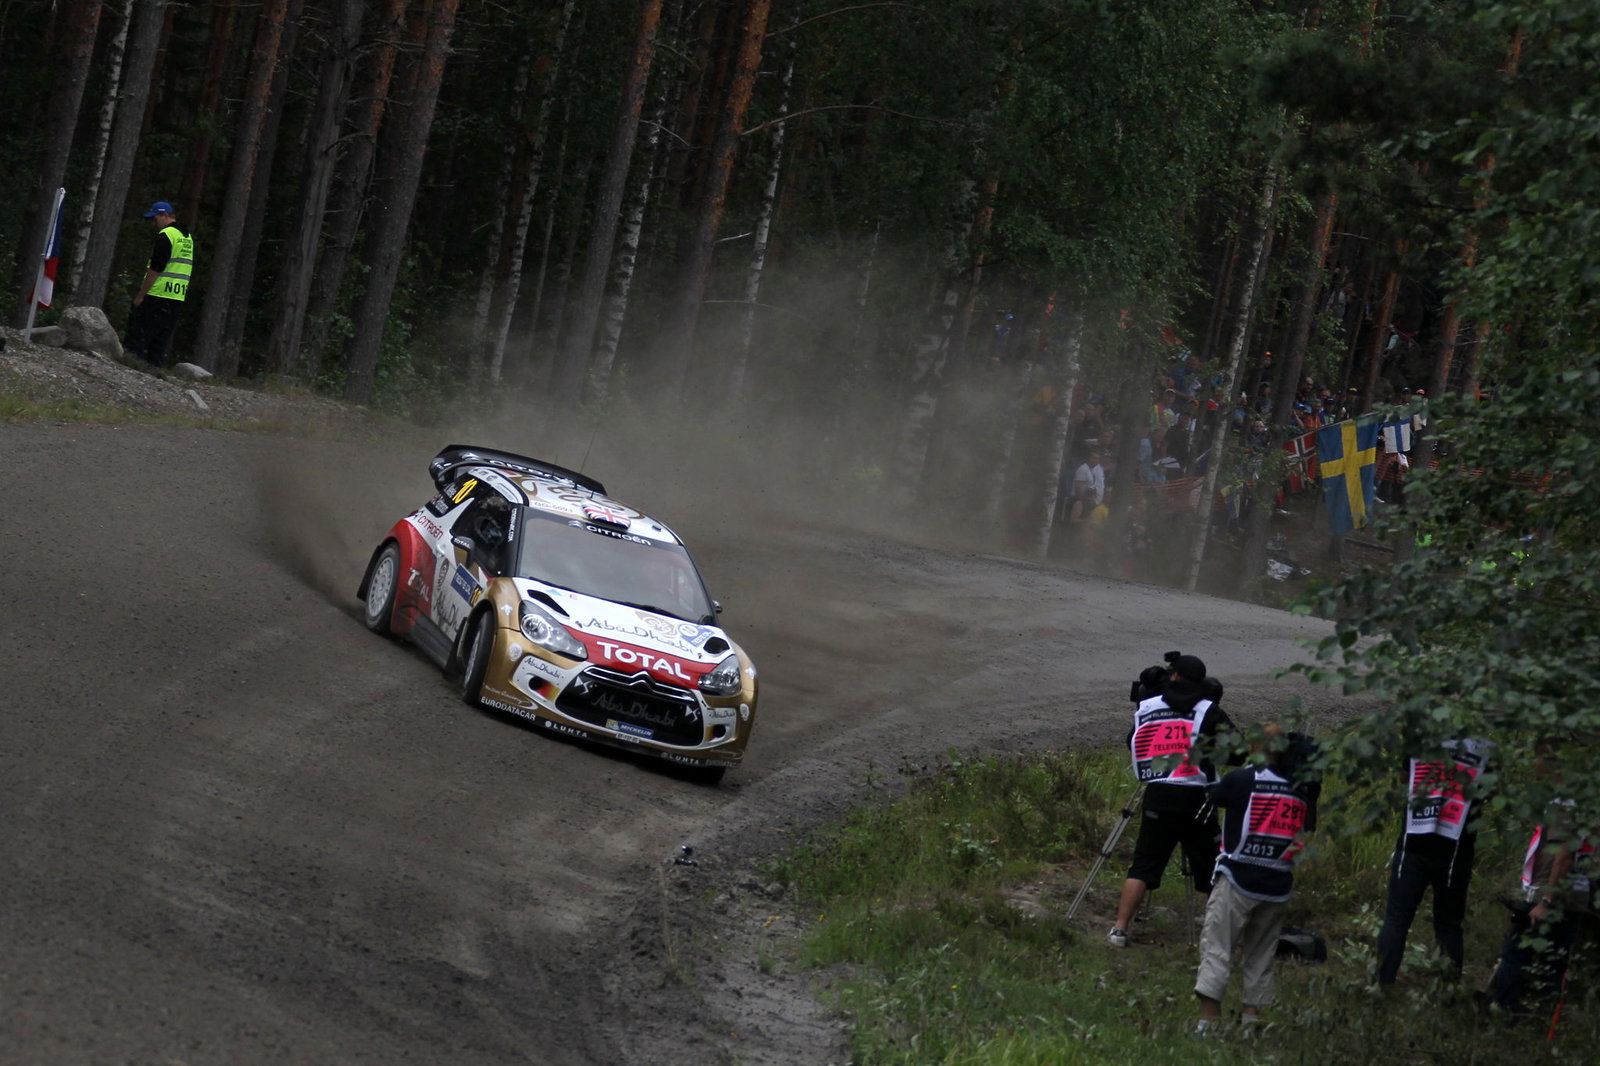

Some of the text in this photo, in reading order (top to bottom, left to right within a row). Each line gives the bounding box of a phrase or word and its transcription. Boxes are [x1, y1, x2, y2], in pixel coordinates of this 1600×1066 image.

[452, 478, 478, 504] 10
[453, 538, 471, 549] TOTAL
[596, 641, 692, 681] TOTAL
[480, 696, 536, 721] EURODATACAR
[553, 723, 588, 738] LUHTA
[620, 724, 653, 737] MICHELIN
[1164, 725, 1188, 740] 271
[669, 754, 700, 766] LUHTA
[1244, 843, 1275, 856] 2013
